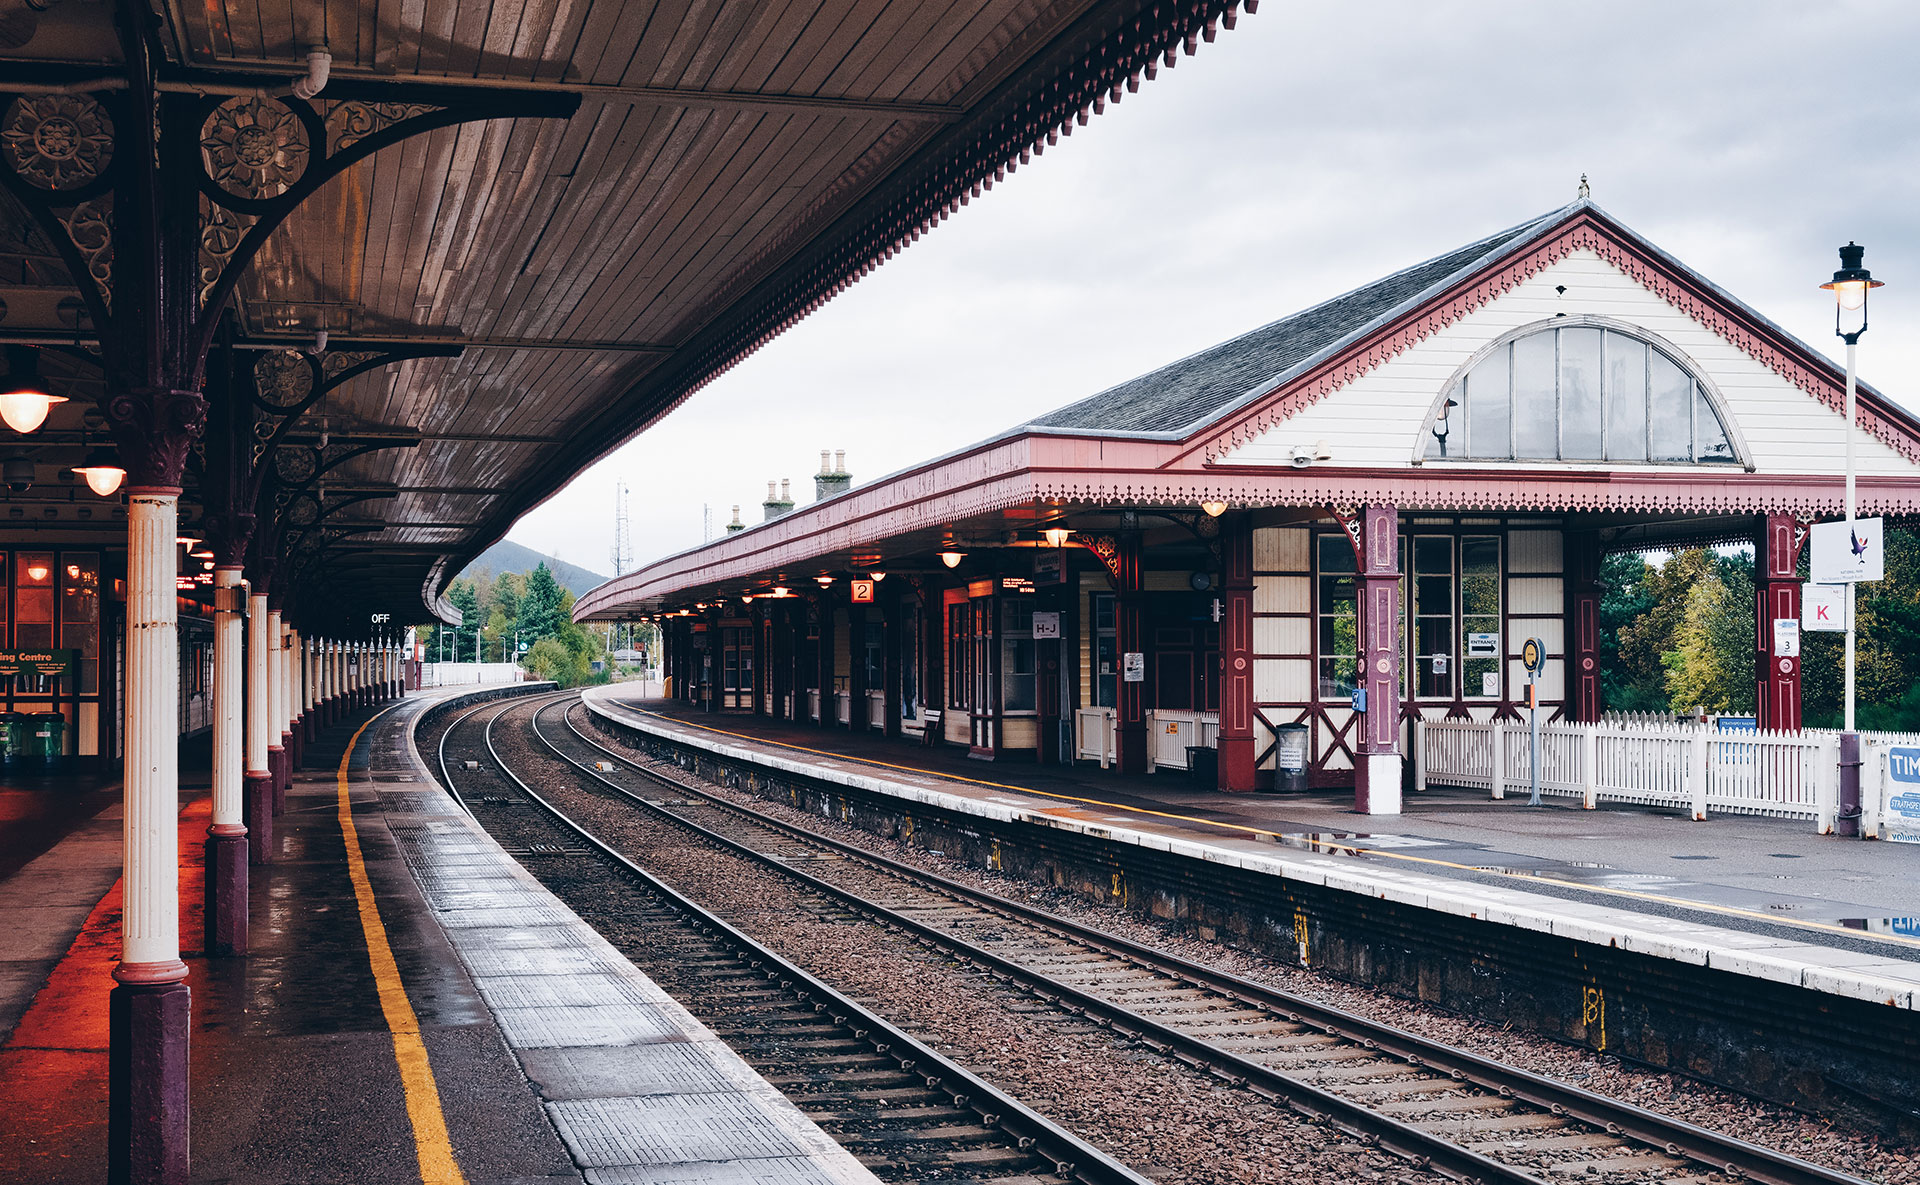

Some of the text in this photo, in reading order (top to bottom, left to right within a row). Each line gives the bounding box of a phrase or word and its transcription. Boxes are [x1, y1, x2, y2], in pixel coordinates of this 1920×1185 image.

[858, 584, 867, 599] 2
[1817, 605, 1829, 620] K
[371, 613, 390, 624] OFF
[1037, 624, 1055, 633] H-J
[1784, 640, 1791, 650] 3
[0, 652, 52, 663] ing Centre
[1892, 754, 1920, 776] TIM
[1891, 799, 1920, 810] STRATHSPE
